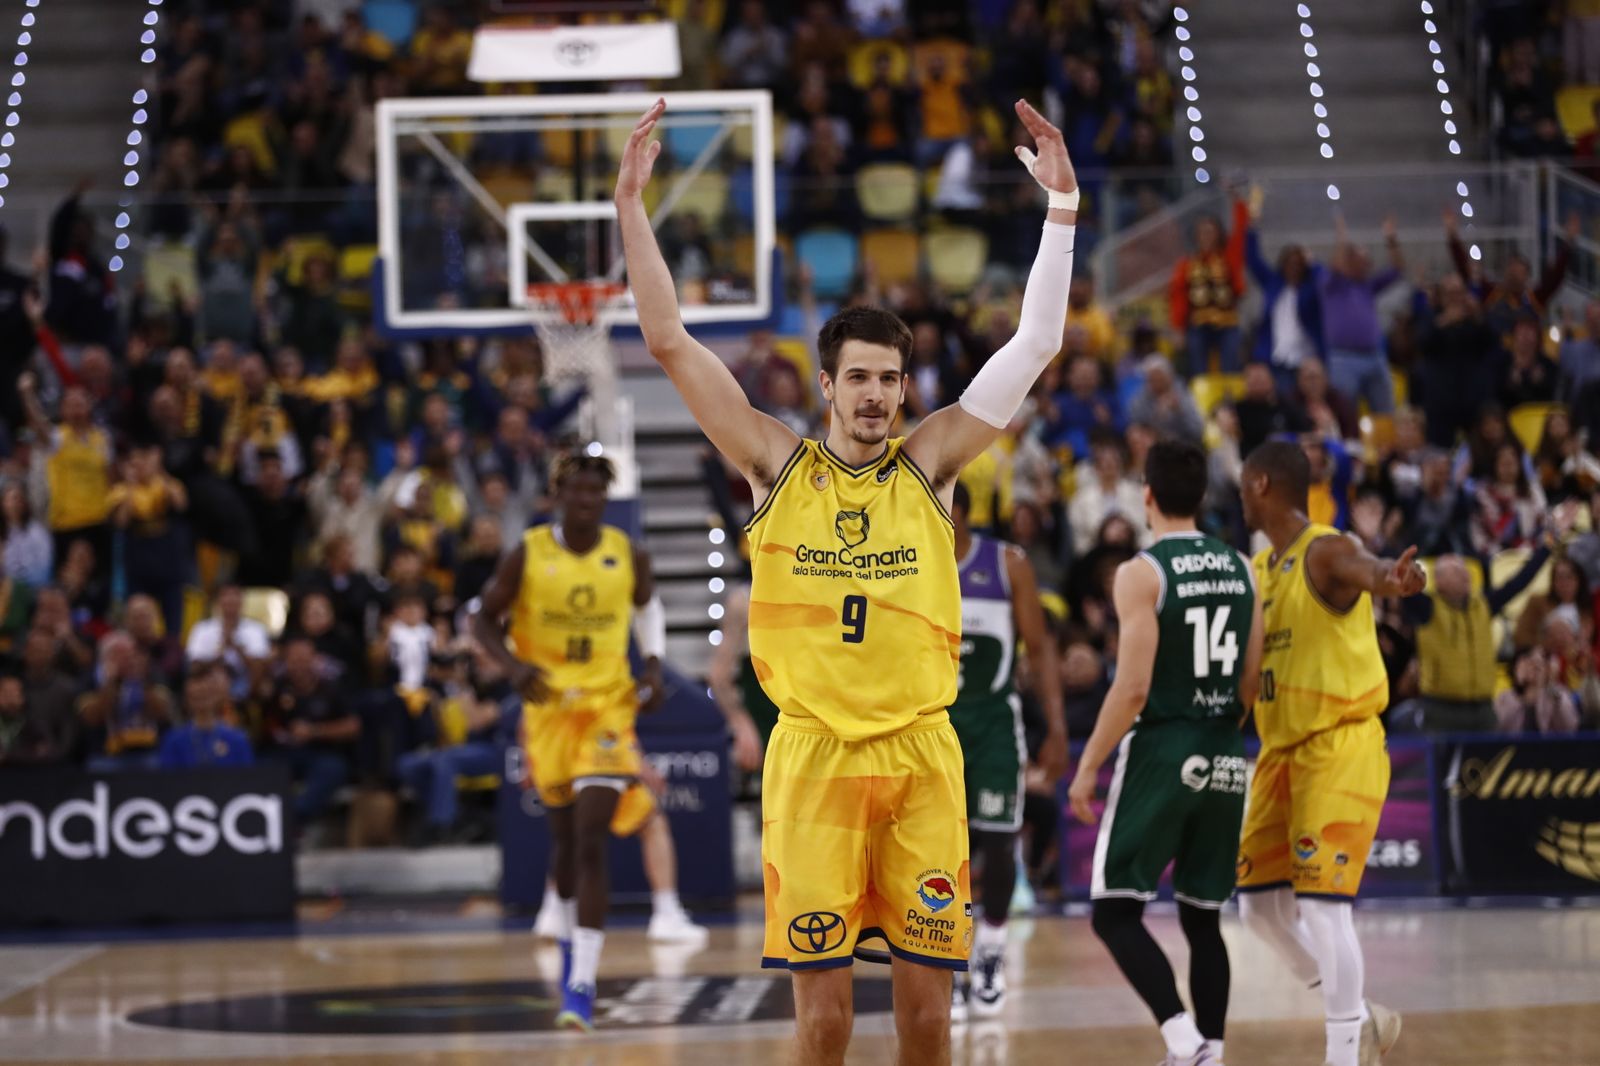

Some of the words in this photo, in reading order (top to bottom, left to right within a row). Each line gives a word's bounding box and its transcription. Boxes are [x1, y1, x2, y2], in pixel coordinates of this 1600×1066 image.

[796, 544, 836, 565] Gran
[838, 545, 917, 569] Canaria
[792, 565, 809, 576] Isla
[810, 566, 853, 579] Europea
[855, 572, 871, 580] del
[875, 567, 919, 580] Deporte
[841, 594, 868, 644] 9
[1184, 605, 1239, 678] 14
[0, 781, 283, 860] ndesa
[906, 908, 956, 931] Poema
[905, 925, 924, 939] del
[928, 928, 954, 944] Mar
